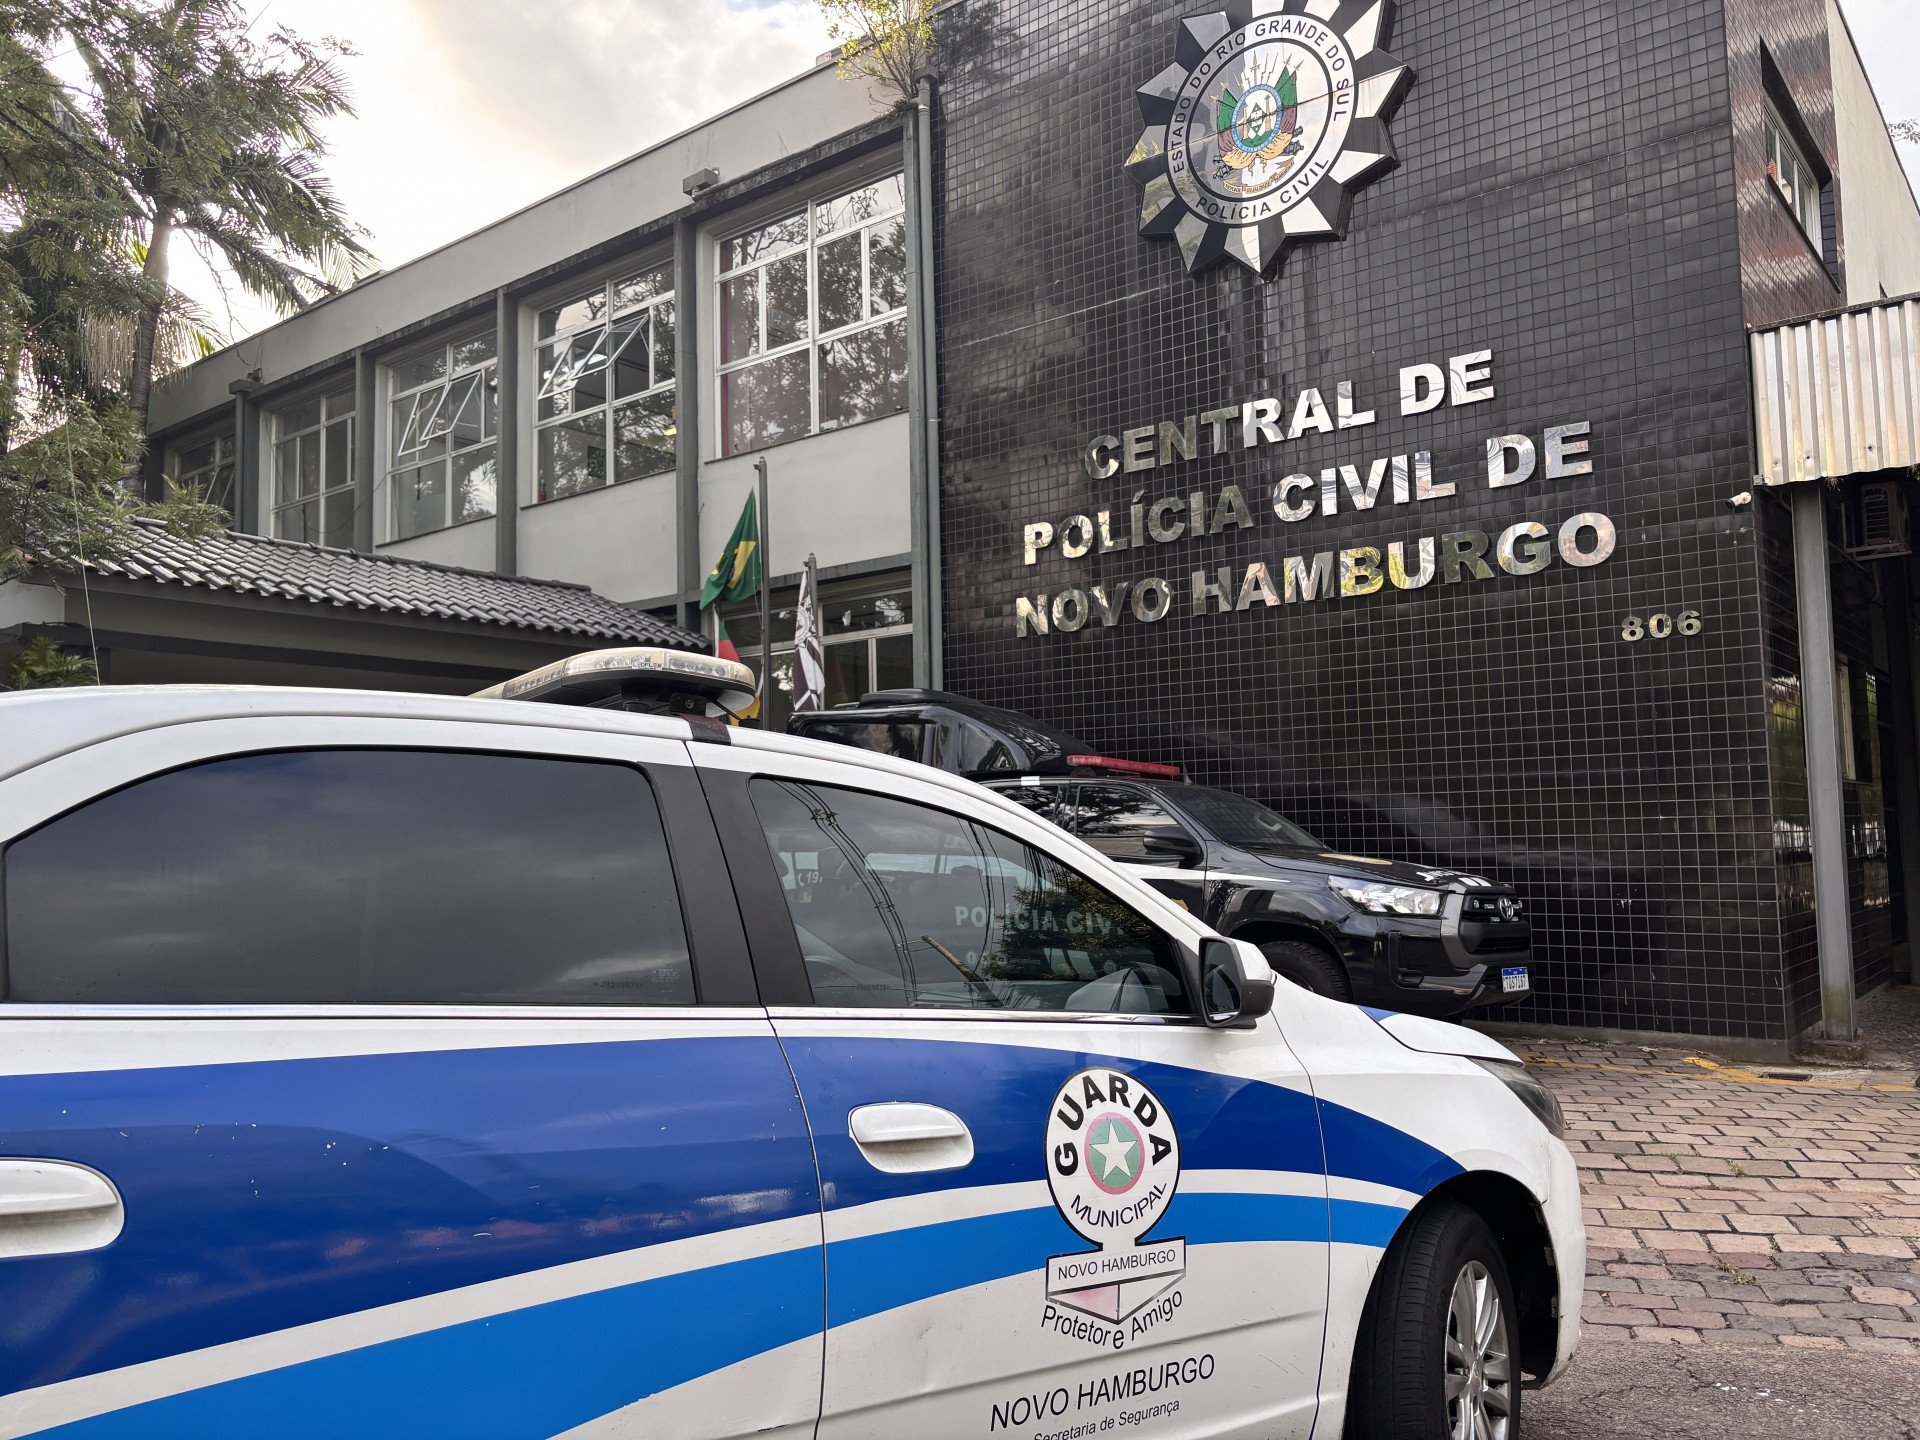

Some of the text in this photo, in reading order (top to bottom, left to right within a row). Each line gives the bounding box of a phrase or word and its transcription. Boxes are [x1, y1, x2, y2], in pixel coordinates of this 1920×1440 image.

[1172, 19, 1350, 174] ESTADO DO RIO GRANDE DO SUL
[1195, 197, 1272, 220] POLÍCIA
[1279, 159, 1330, 204] CIVIL
[1084, 348, 1497, 480] CENTRAL DE
[1023, 421, 1594, 565] POLÍCIA CIVIL DE
[1015, 512, 1618, 638] NOVO HAMBURGO
[1620, 610, 1703, 641] 806
[1054, 1072, 1172, 1176] GUARDA
[1070, 1182, 1168, 1228] MUNICIPAL
[1058, 1248, 1176, 1281] NOVO HAMBURGO
[1041, 1290, 1184, 1350] Protetor e Amigo
[990, 1353, 1215, 1432] NOVO HAMBURGO
[1100, 1416, 1115, 1431] de
[1118, 1400, 1180, 1426] Segurança
